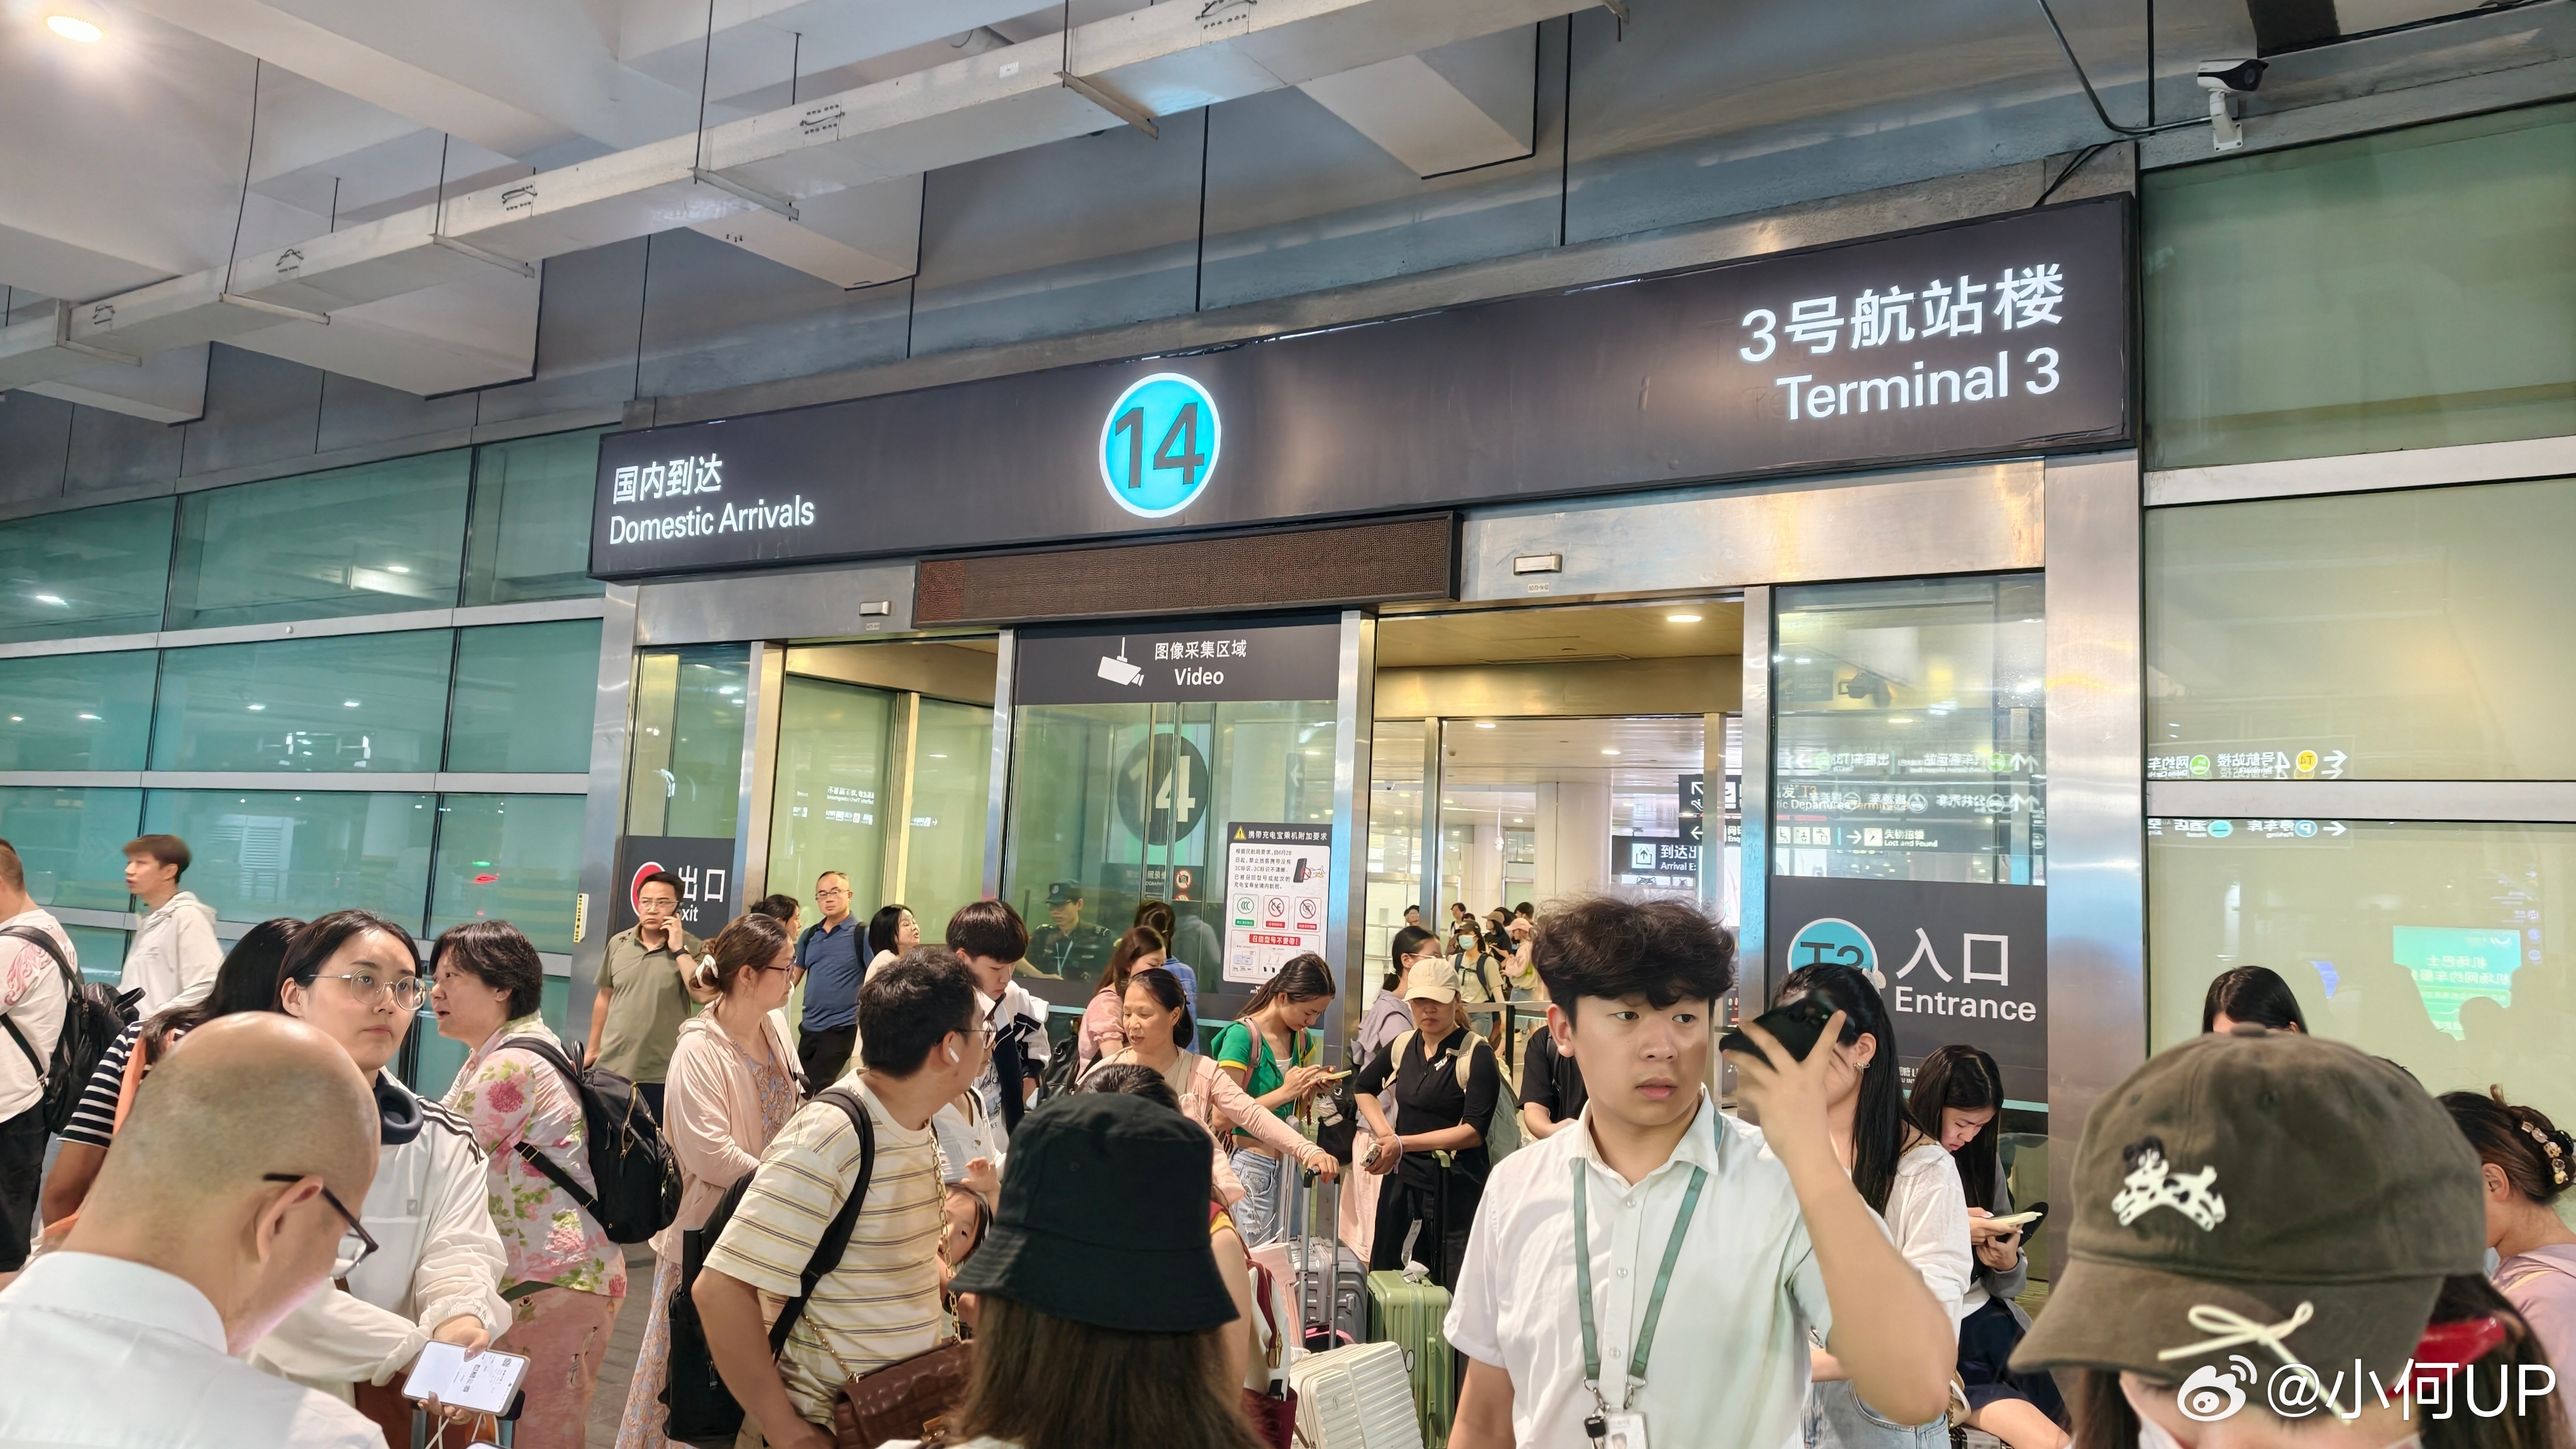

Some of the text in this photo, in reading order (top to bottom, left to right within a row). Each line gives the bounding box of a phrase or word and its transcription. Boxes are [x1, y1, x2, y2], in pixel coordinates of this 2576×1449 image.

[1740, 262, 2065, 363] 3号航站楼
[1776, 346, 2061, 420] Terminal 3
[1115, 402, 1205, 489] 14
[612, 453, 723, 504] 国内到达
[609, 494, 815, 545] Domestic Arrivals
[1155, 639, 1247, 660] 图像采集区域
[1174, 667, 1224, 686] Video
[1128, 755, 1196, 823] 14
[1248, 830, 1328, 841] 携带充电宝乘机附加要求
[678, 865, 726, 902] 出口
[1660, 862, 1687, 870] Arrival
[681, 904, 699, 922] xit
[1896, 927, 2009, 986] 入口
[1895, 985, 2038, 1022] Entrance
